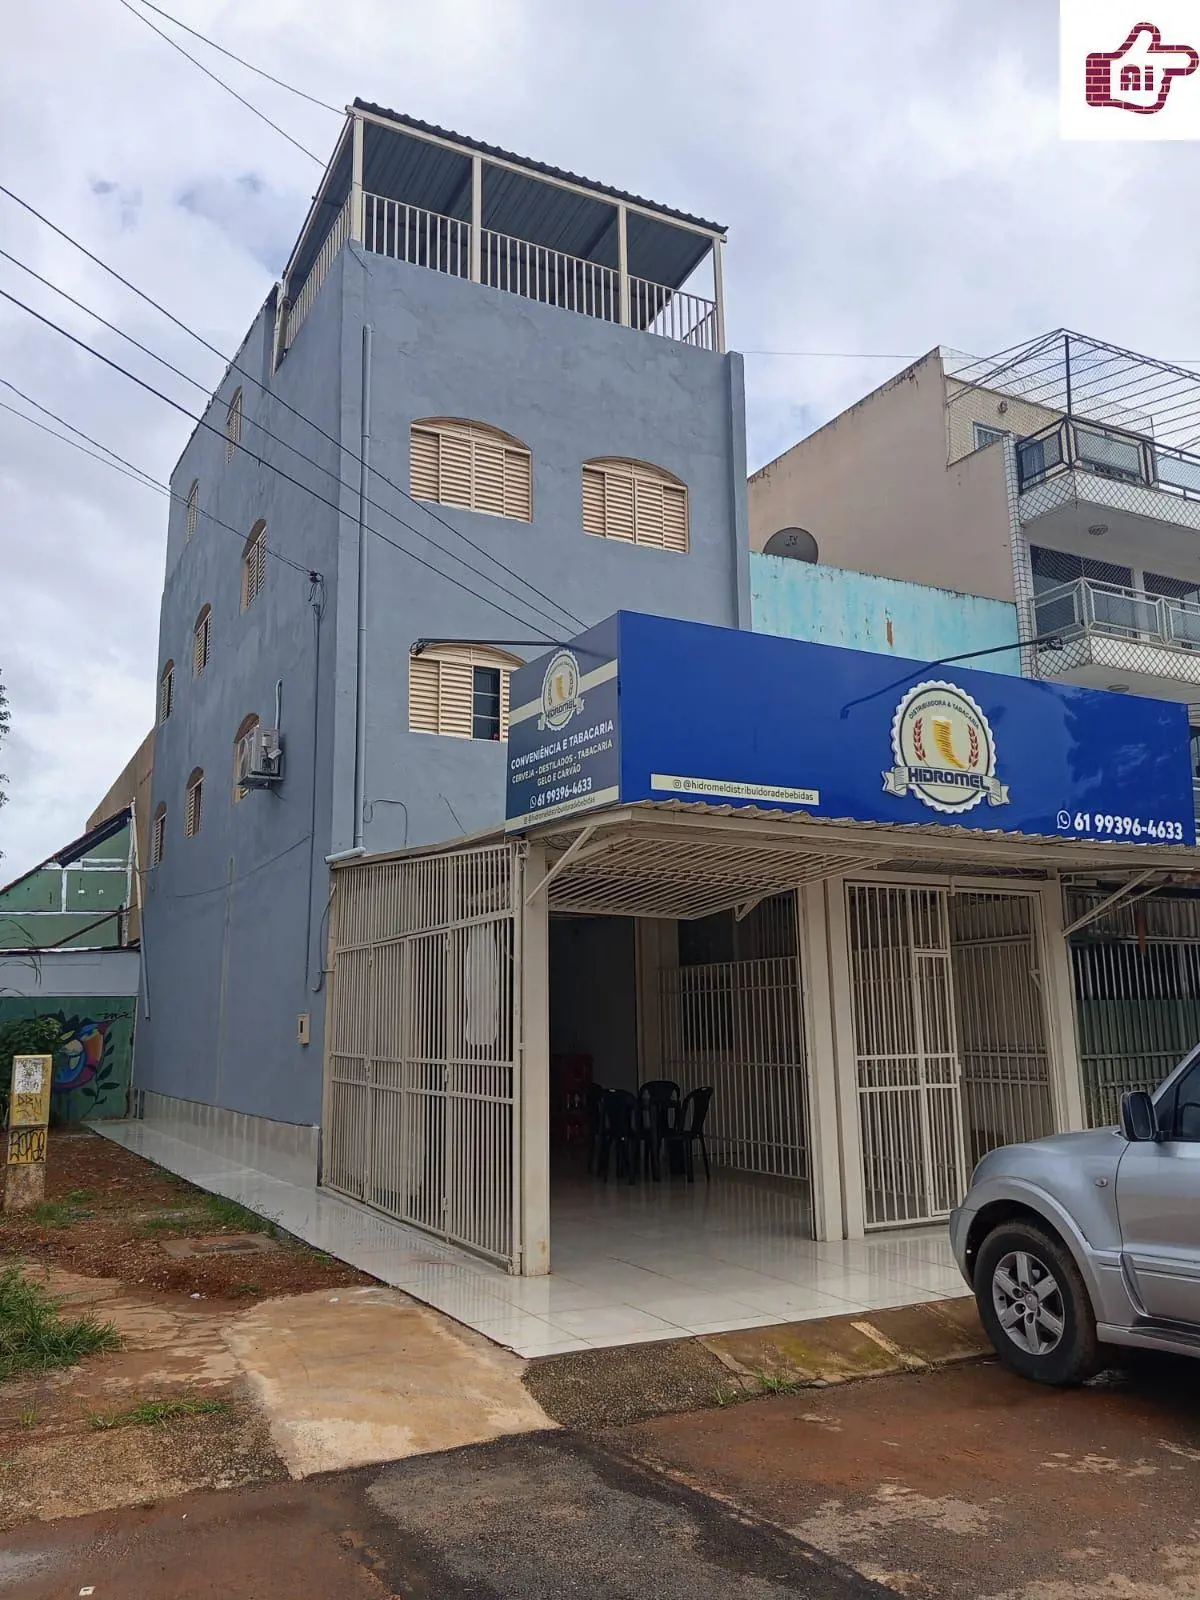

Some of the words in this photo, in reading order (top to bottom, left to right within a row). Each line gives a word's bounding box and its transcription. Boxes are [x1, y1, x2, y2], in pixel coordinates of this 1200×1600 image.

[510, 742, 561, 770] CONVENIÊNCIA
[562, 738, 568, 750] E
[569, 719, 614, 748] TABACARIA
[511, 769, 535, 784] CERVEJA
[538, 754, 573, 775] DESTILADOS
[577, 739, 613, 759] TABACARIA
[537, 775, 551, 787] GELO
[557, 763, 581, 780] CARVÃO
[537, 793, 545, 807] 61
[546, 777, 592, 804] 99396-4633
[683, 779, 814, 801] @hidromeldistribuidoradebebidas
[908, 767, 991, 791] HIDROMEL
[1074, 812, 1091, 832] 61
[1094, 813, 1183, 840] 99396-4633
